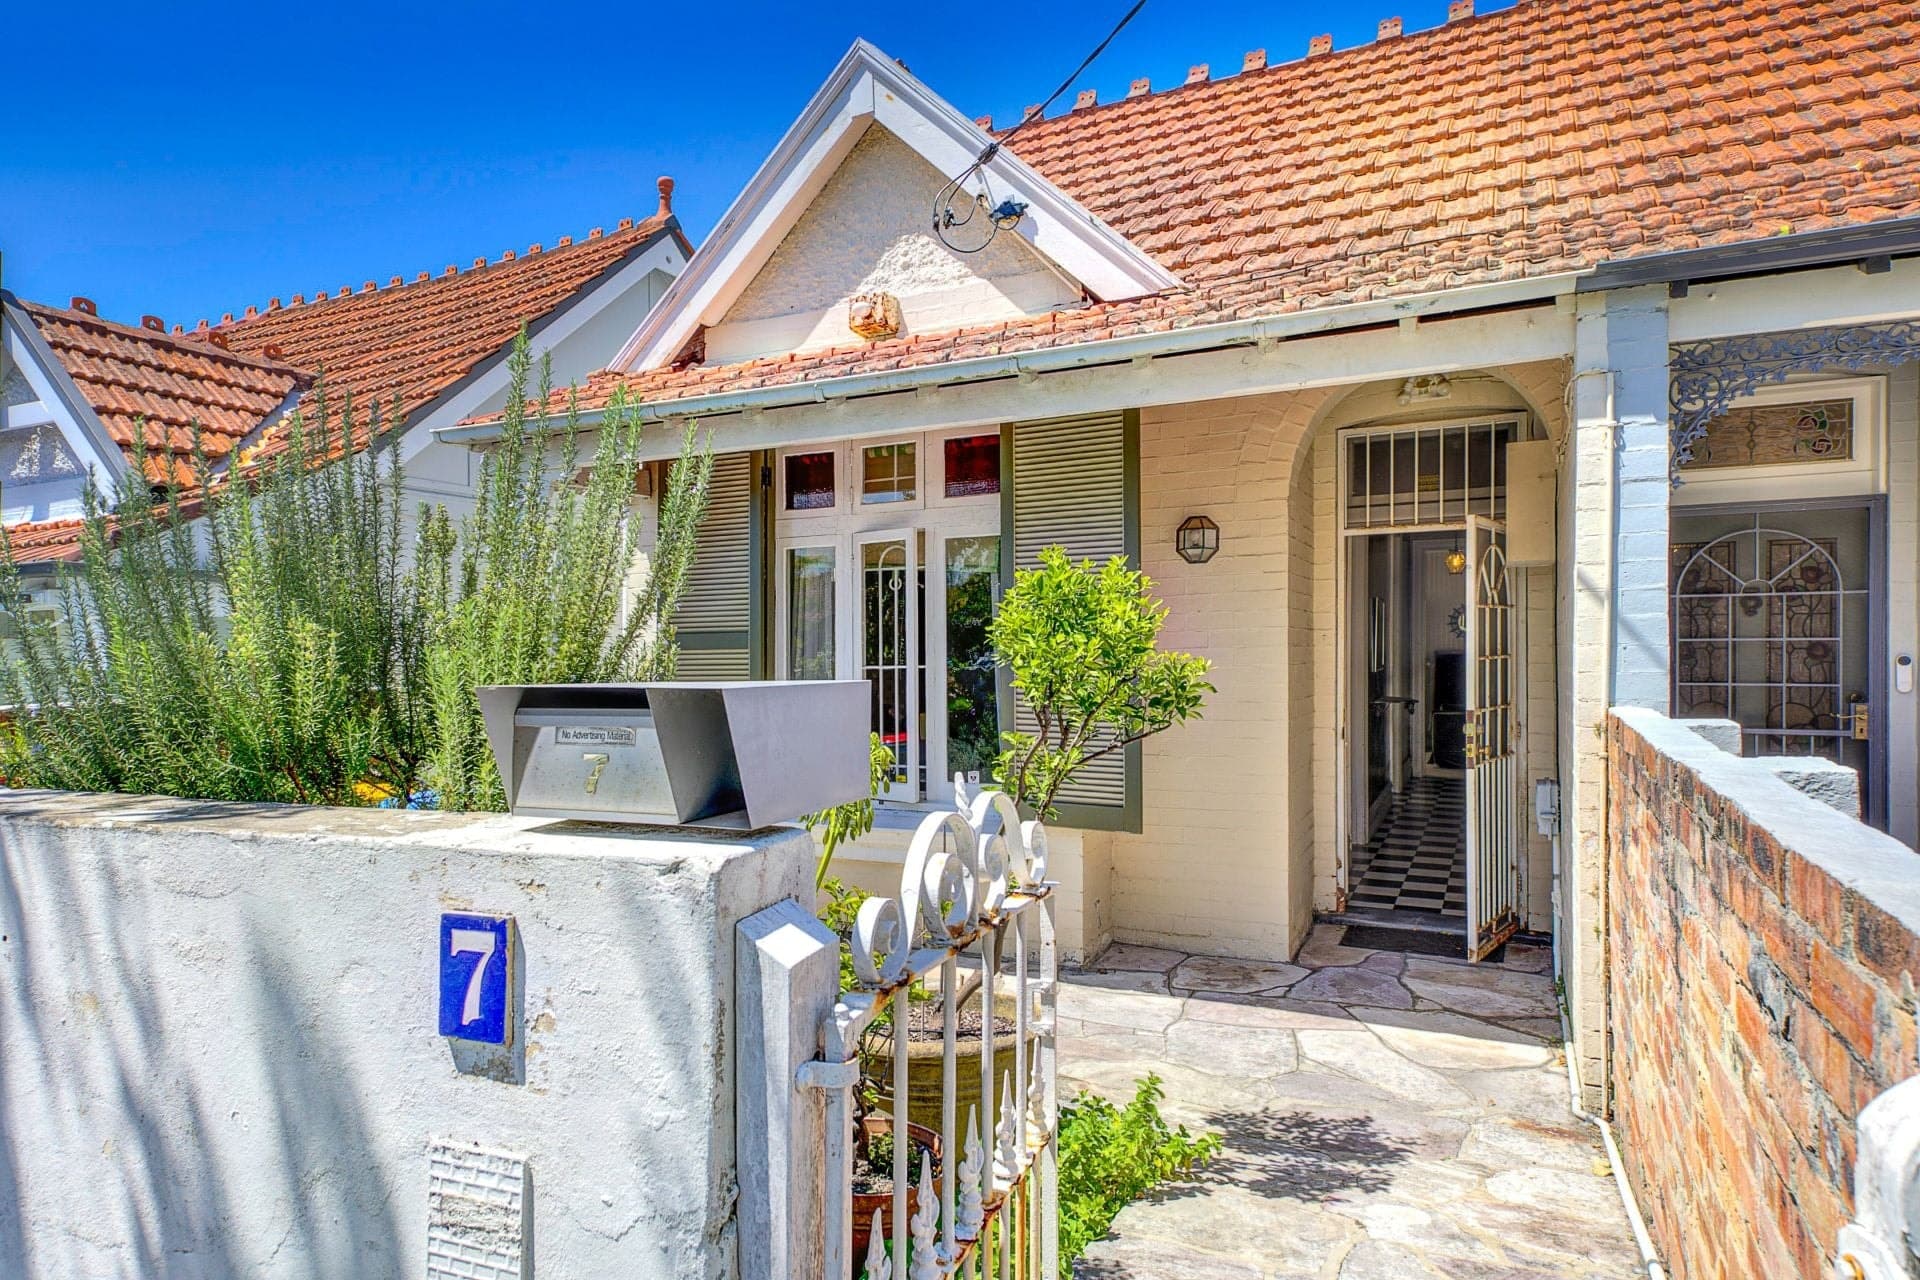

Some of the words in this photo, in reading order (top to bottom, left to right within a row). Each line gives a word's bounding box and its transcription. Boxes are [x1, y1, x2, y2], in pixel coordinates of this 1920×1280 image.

[562, 729, 571, 739] No
[572, 730, 606, 742] Advertising
[583, 753, 609, 794] 7
[450, 928, 496, 1026] 7
